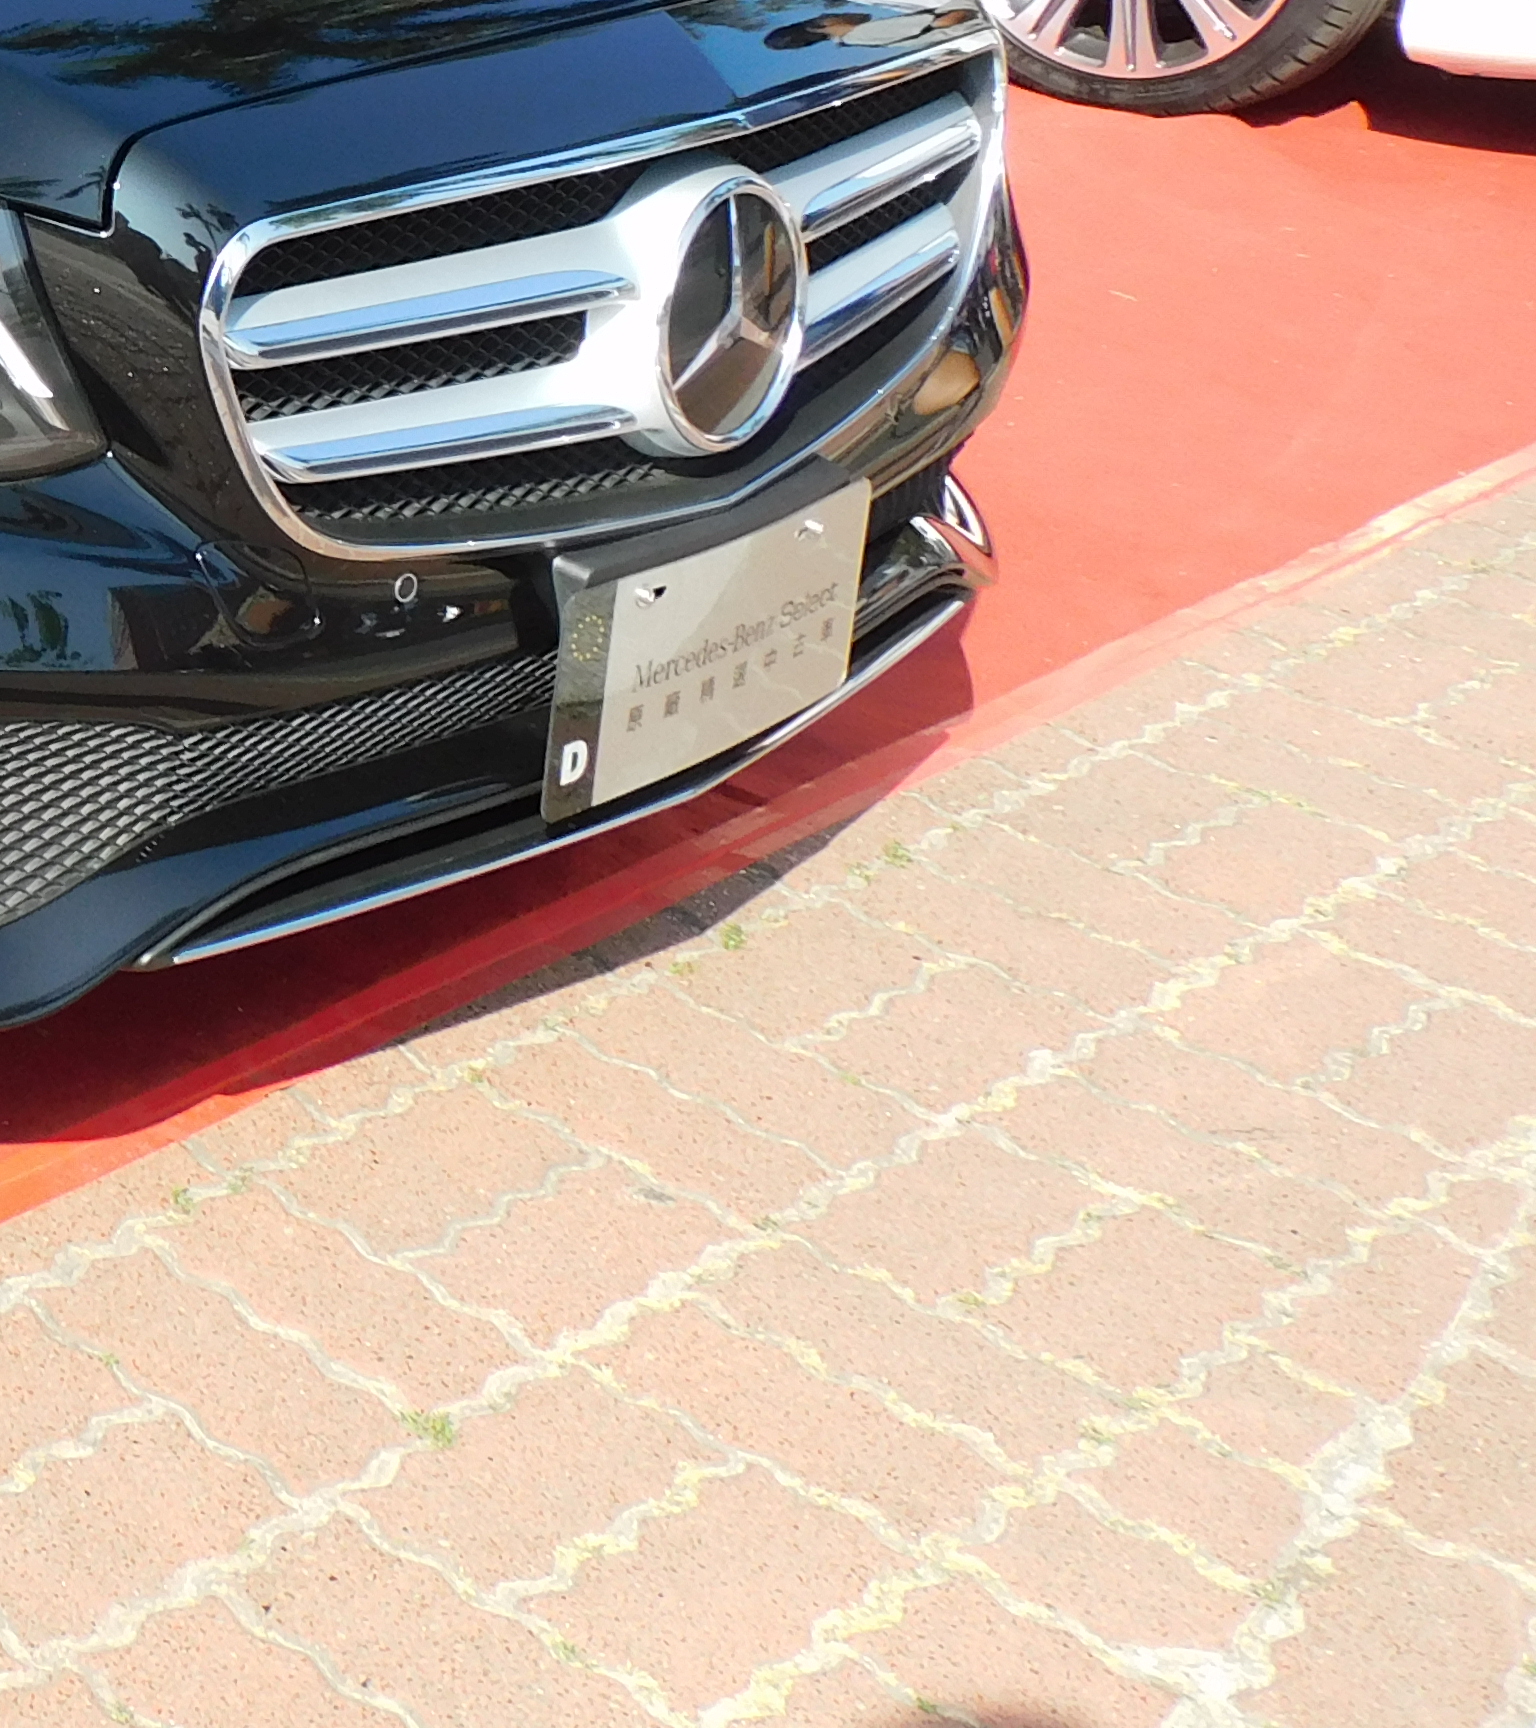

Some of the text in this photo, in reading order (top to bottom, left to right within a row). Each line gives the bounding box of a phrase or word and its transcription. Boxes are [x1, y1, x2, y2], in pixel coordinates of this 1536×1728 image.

[631, 582, 838, 693] Mercedes-Benz Select
[559, 739, 588, 786] D
